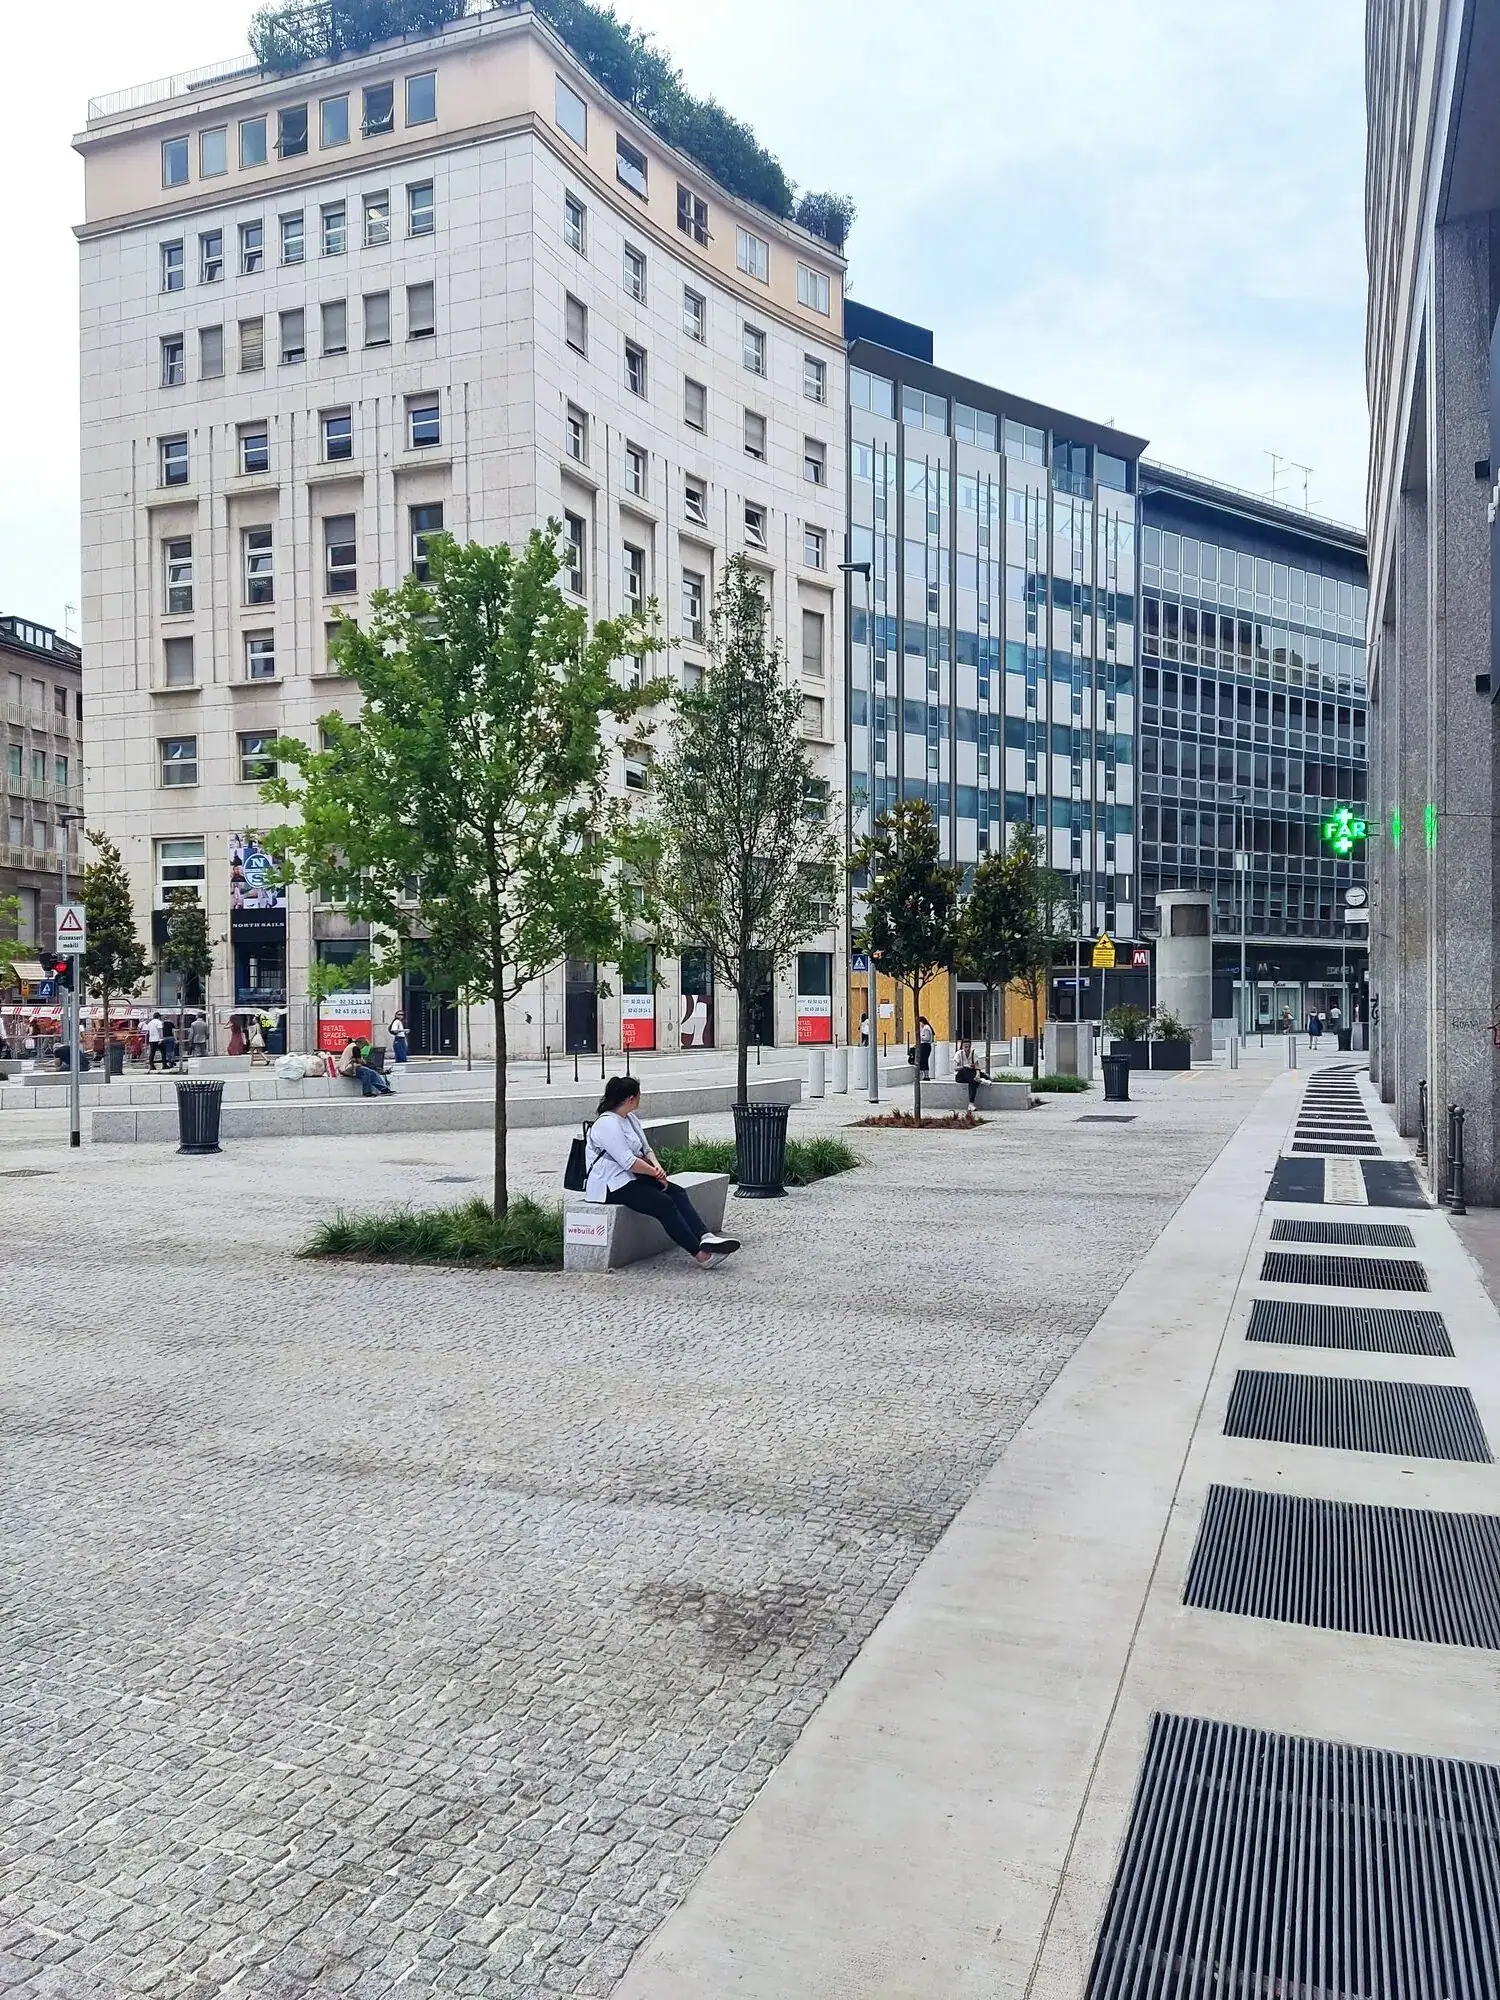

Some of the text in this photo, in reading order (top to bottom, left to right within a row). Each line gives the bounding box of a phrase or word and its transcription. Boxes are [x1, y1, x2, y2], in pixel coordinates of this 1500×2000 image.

[1326, 821, 1367, 838] FAR
[251, 857, 265, 868] N
[1133, 952, 1146, 964] M
[323, 1038, 346, 1046] TO LET
[568, 1227, 595, 1235] webuild
